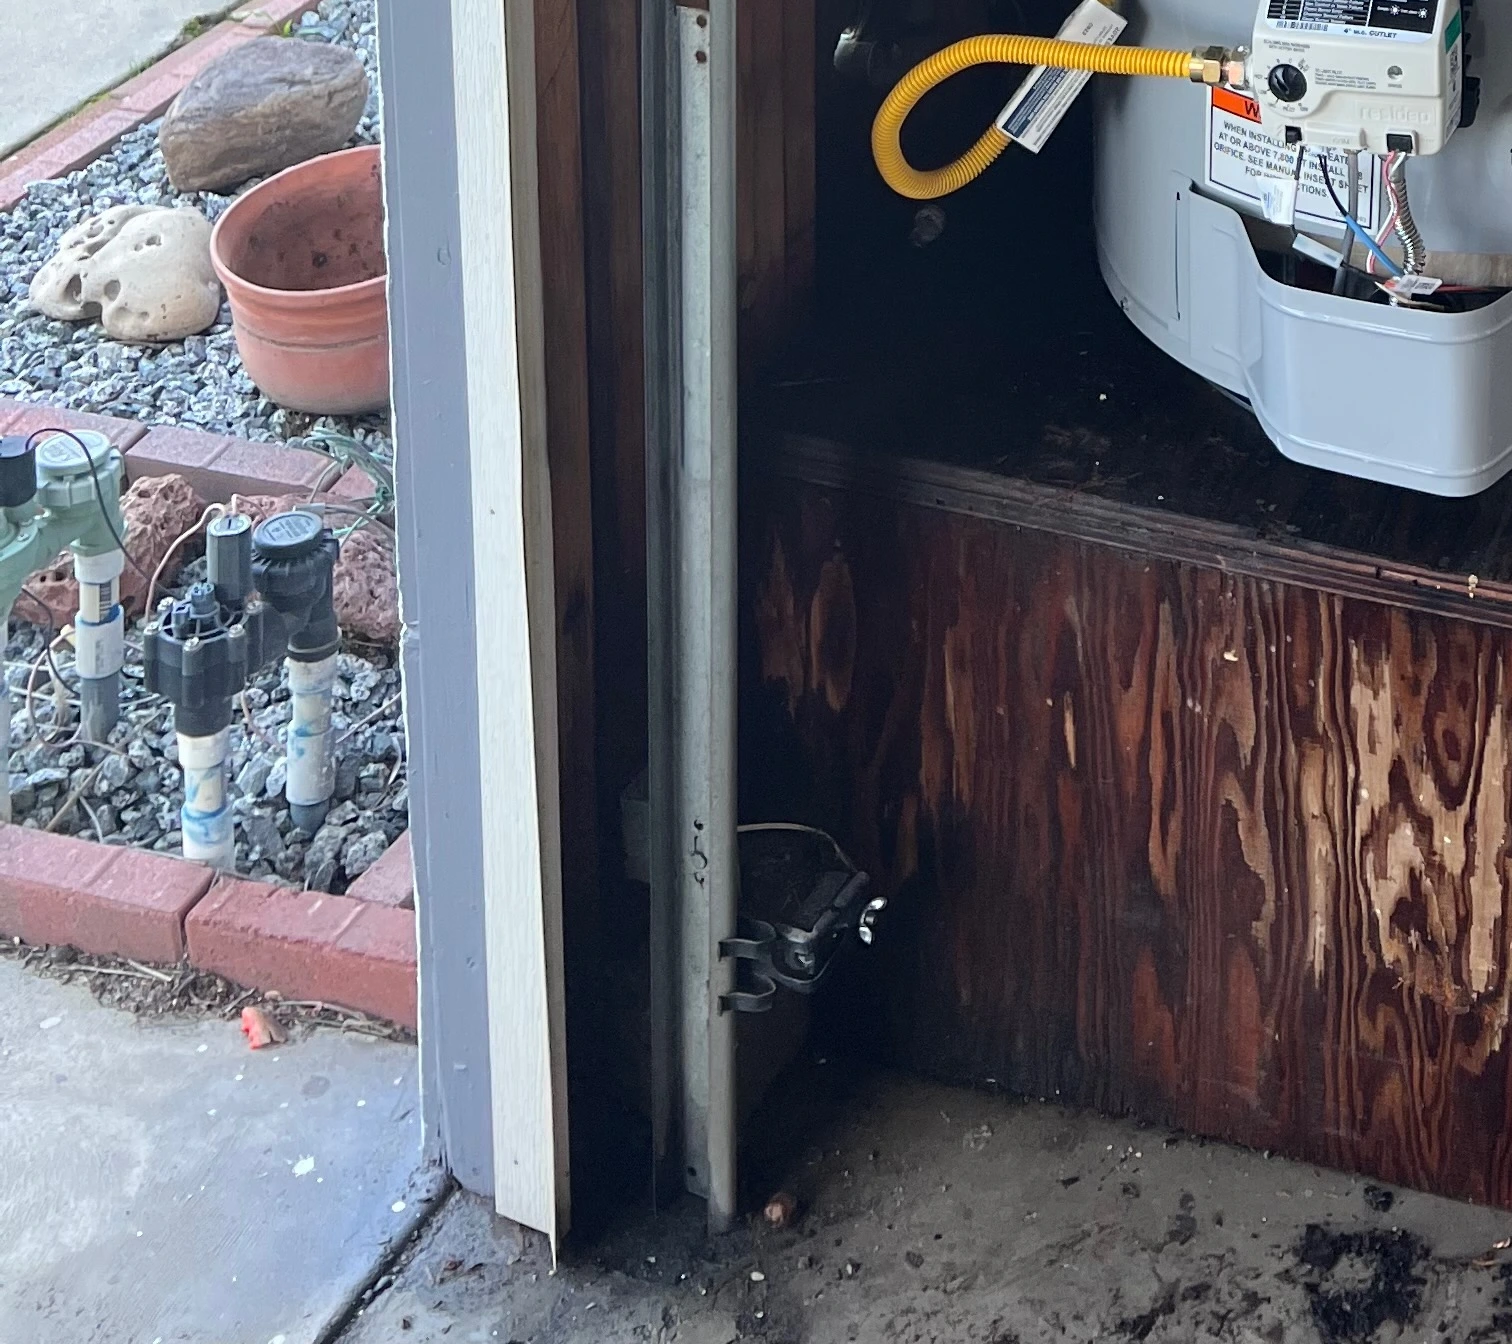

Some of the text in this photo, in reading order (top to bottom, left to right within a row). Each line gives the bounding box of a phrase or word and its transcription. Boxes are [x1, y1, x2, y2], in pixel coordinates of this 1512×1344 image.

[1369, 30, 1397, 38] OUTLET
[1224, 120, 1247, 136] WHEN
[1219, 132, 1228, 142] AT
[1230, 136, 1241, 146] OR
[1243, 142, 1272, 157] ABOVE
[1214, 143, 1245, 162] ORIFICE.
[1247, 156, 1263, 168] SEE
